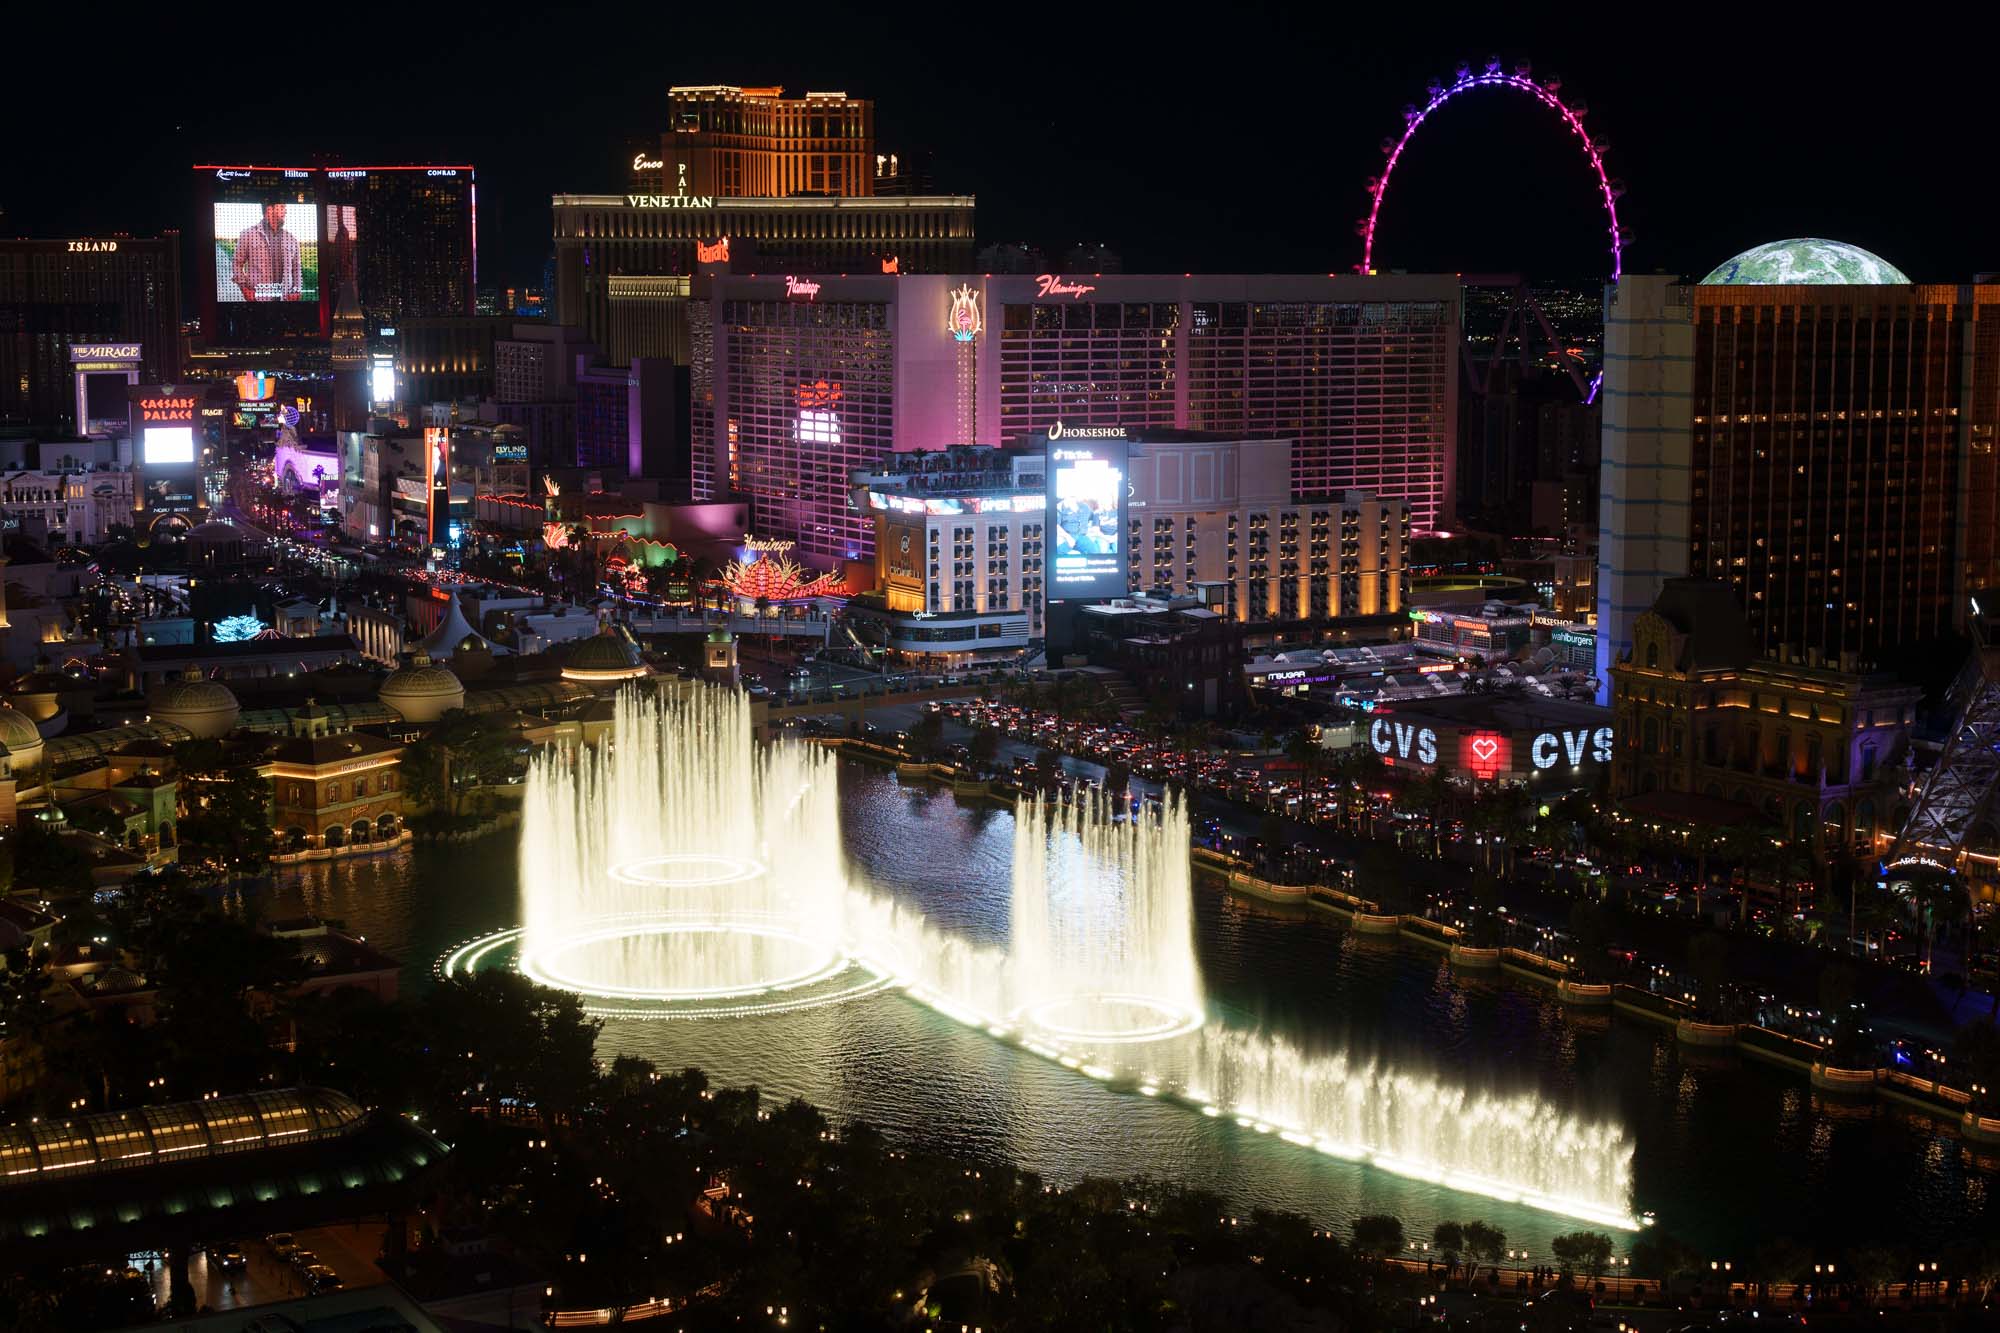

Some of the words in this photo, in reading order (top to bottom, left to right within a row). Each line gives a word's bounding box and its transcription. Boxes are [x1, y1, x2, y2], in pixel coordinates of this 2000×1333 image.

[284, 170, 308, 178] Hilton
[627, 195, 713, 208] VENETIAN
[67, 241, 118, 252] ISLAND
[786, 275, 821, 299] Flamingo
[1036, 275, 1095, 299] Flamingo
[82, 346, 139, 358] MIRAGE
[140, 398, 195, 409] CAESARS
[143, 410, 193, 420] PALACE
[1062, 427, 1127, 438] HORSESHOE
[743, 533, 796, 553] Flamingo
[1552, 632, 1593, 646] wahlburgers
[1371, 719, 1438, 764] CVS
[1532, 727, 1614, 768] CVS
